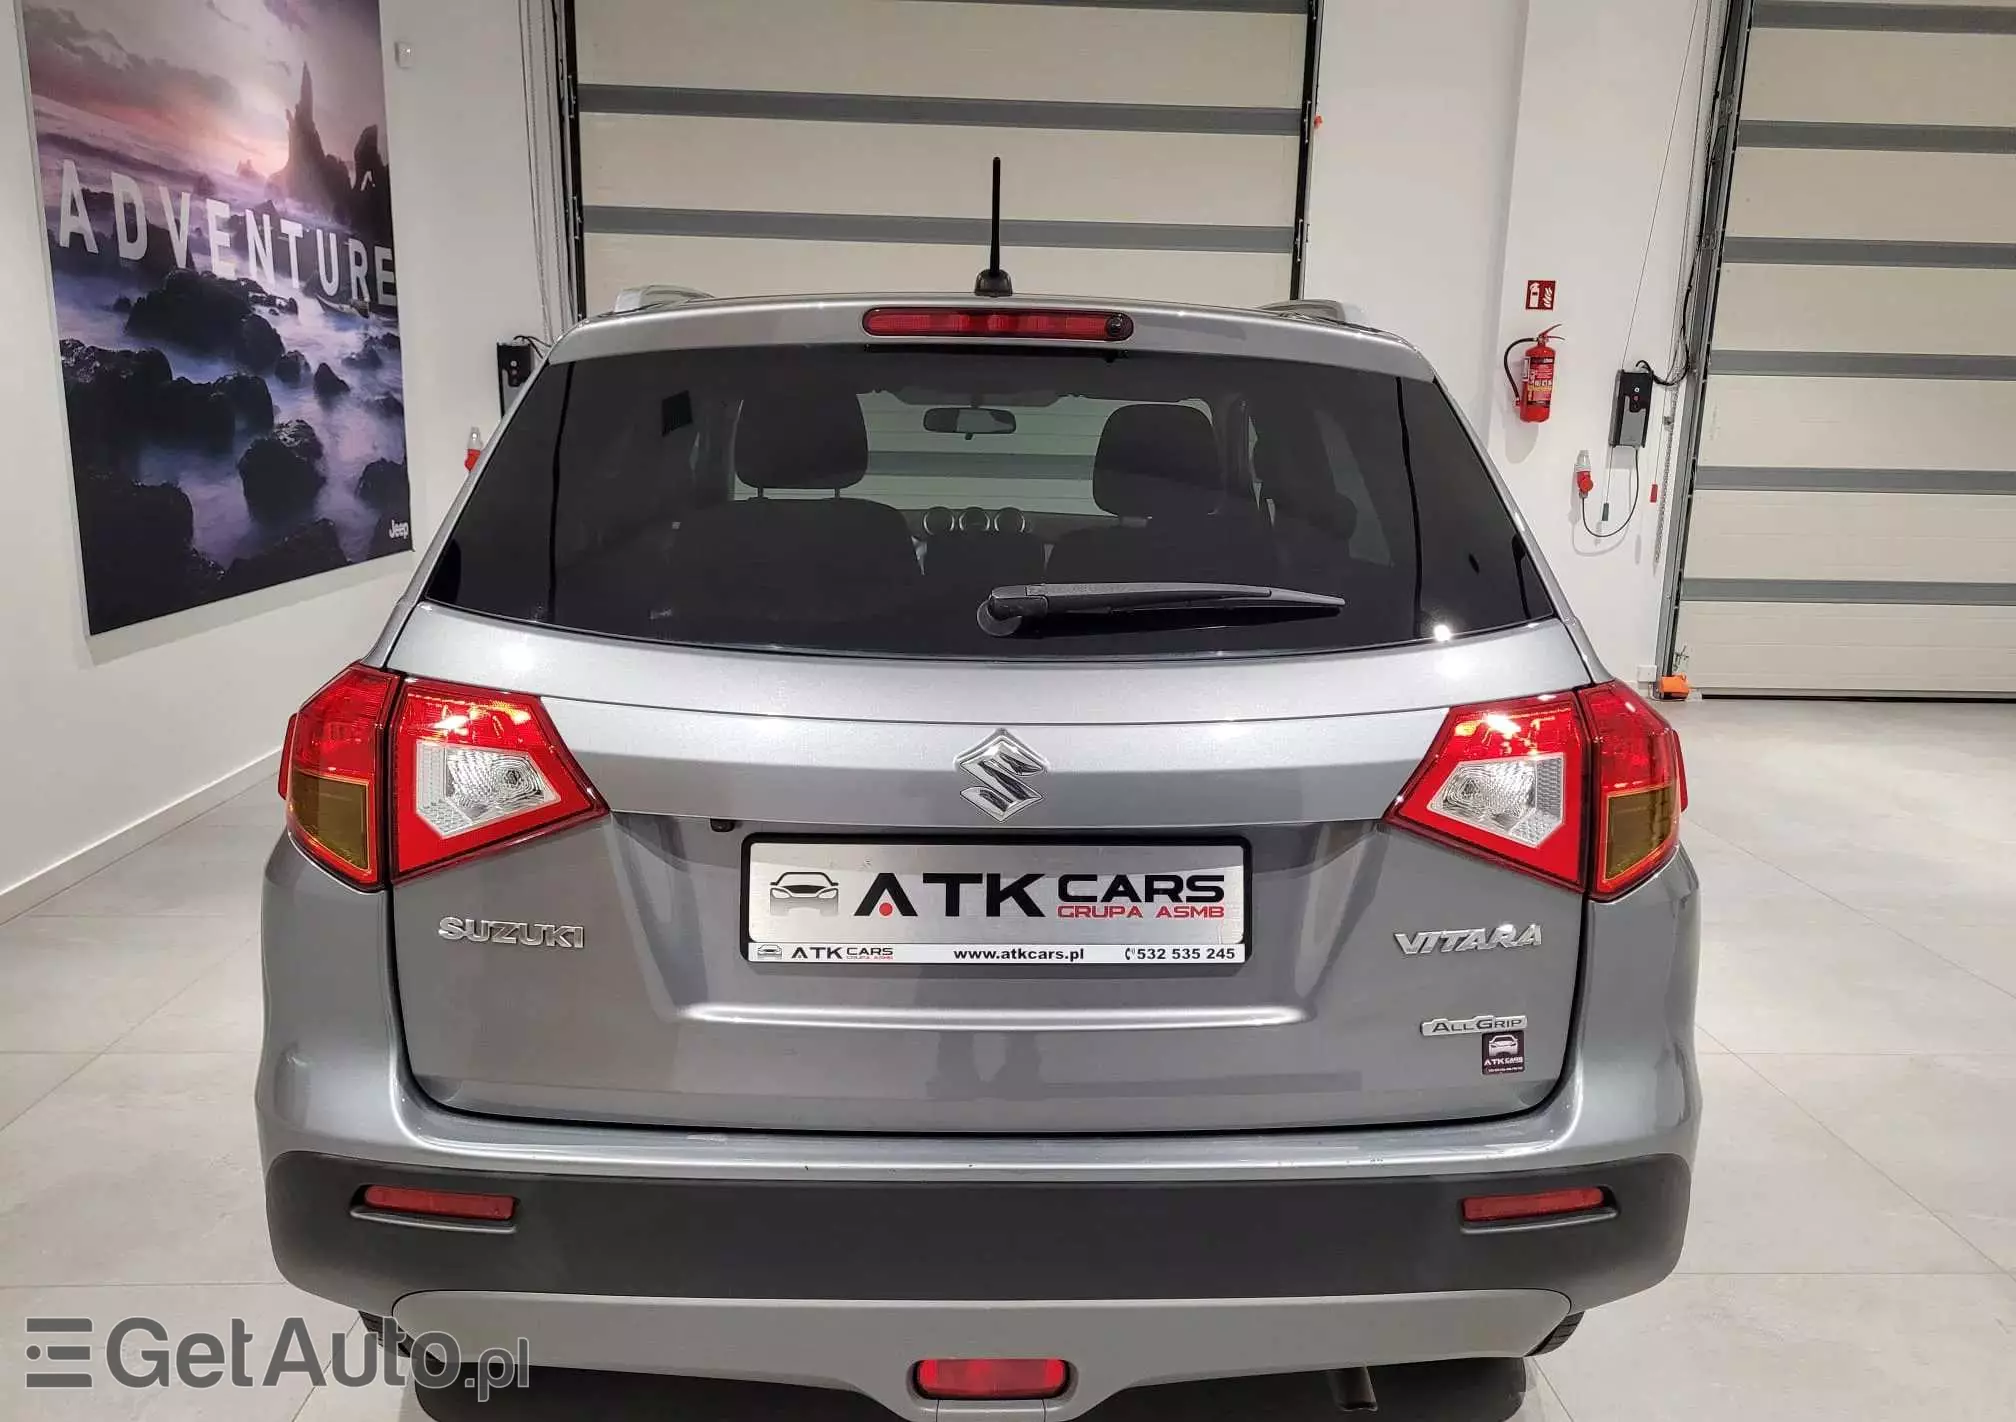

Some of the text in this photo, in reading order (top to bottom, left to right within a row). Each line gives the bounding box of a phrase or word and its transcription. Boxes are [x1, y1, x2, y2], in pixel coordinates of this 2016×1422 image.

[58, 158, 396, 306] ADVENTURE
[389, 519, 409, 539] Jeep
[854, 872, 1225, 917] ATK CARS
[1056, 904, 1225, 919] GRUPA ASMB
[438, 916, 584, 948] SUZUKI
[1394, 923, 1542, 955] VITARA
[791, 946, 843, 959] ATK
[846, 947, 894, 956] CARS
[953, 948, 1085, 961] www.atkcars.pl
[1136, 948, 1236, 960] 532 535 245
